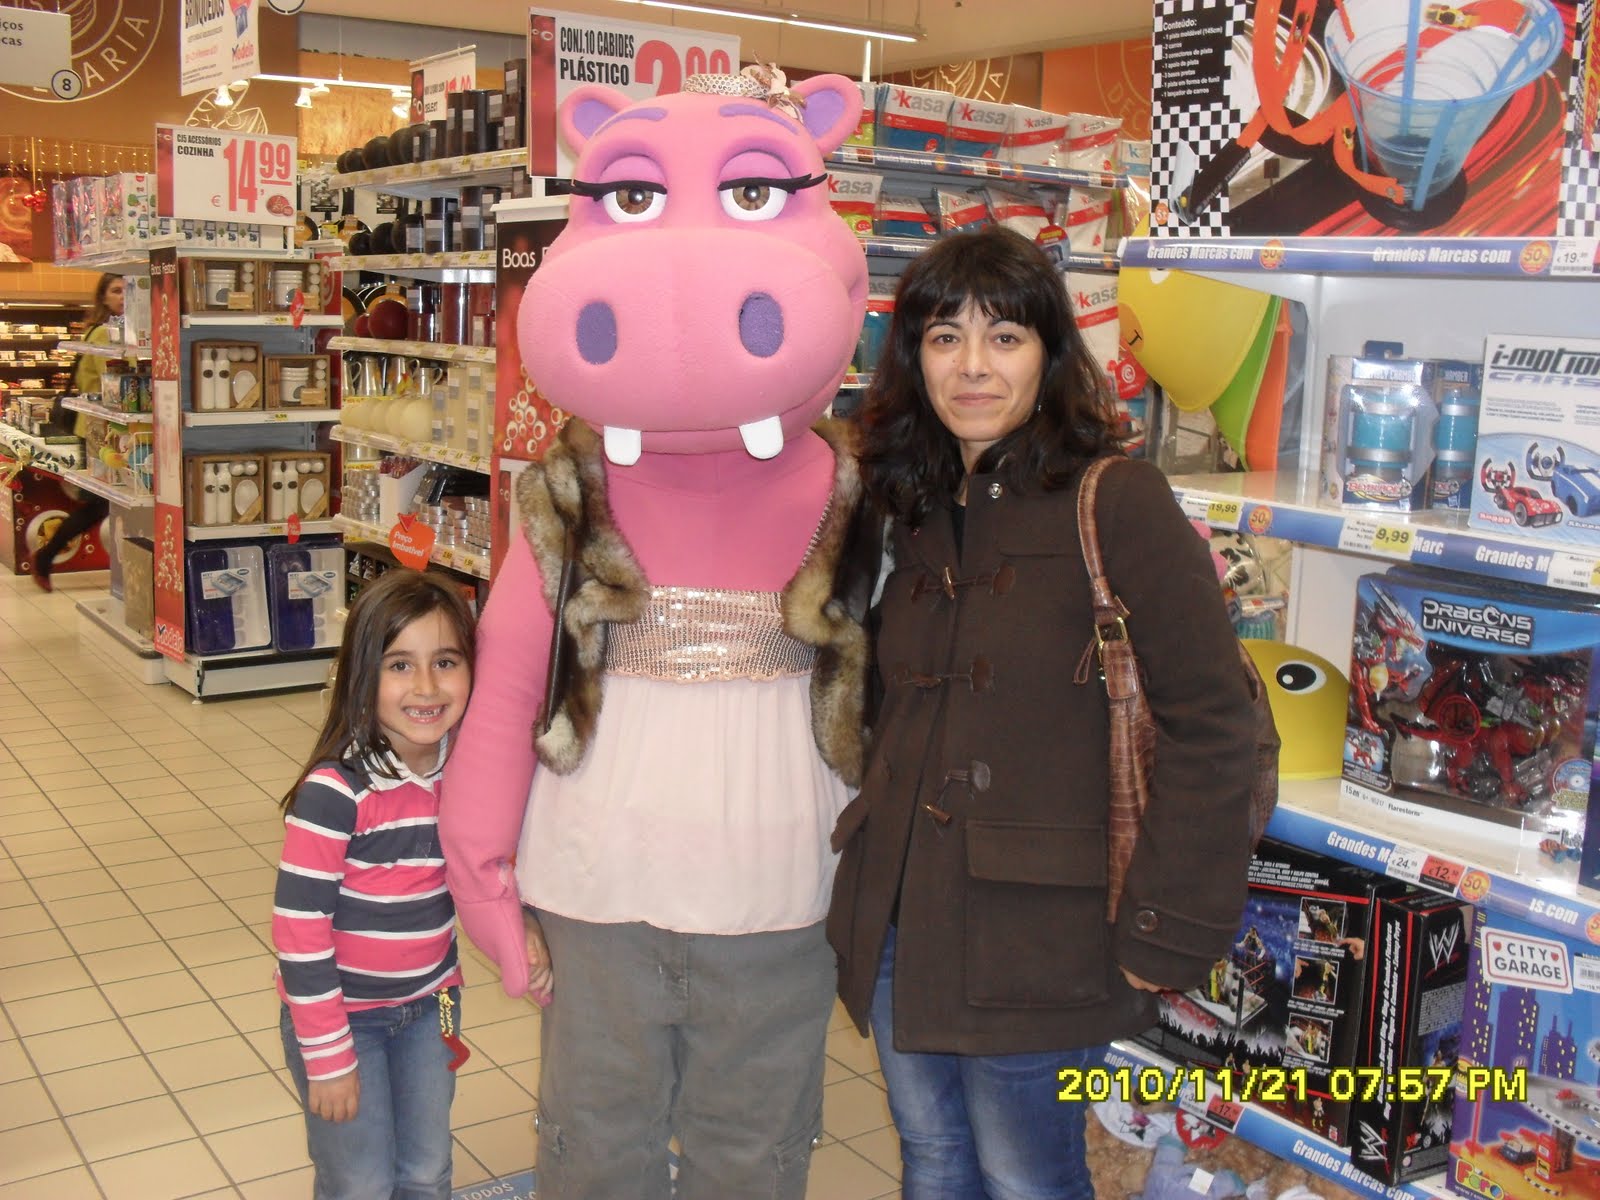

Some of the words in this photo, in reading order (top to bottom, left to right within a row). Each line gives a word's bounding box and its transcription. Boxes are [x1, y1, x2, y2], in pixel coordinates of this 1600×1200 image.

[1163, 18, 1197, 30] Conteúdo:
[597, 31, 635, 59] CABIDES
[560, 57, 629, 86] PLÁSTICO
[62, 78, 72, 91] 8
[899, 90, 945, 114] kasa
[961, 103, 1007, 125] kasa
[177, 145, 214, 157] COZINHA
[828, 174, 873, 195] kasa
[502, 248, 536, 268] Boas
[1147, 245, 1189, 259] Grandes
[1189, 245, 1229, 259] Marcas
[1229, 247, 1253, 260] com
[1372, 246, 1426, 262] Grandes
[1427, 247, 1481, 263] Marcas
[1480, 249, 1511, 264] com
[394, 530, 413, 543] Preço
[1413, 536, 1444, 555] Marc
[1475, 545, 1533, 570] Grandes
[1327, 830, 1378, 859] Grandes
[1545, 903, 1579, 925] com
[1506, 942, 1547, 961] CITY
[1494, 957, 1562, 979] GARAGE
[1103, 1051, 1134, 1071] andes
[1293, 1139, 1341, 1173] Grandes
[1340, 1161, 1386, 1195] Marcas
[1386, 1185, 1415, 1200] com
